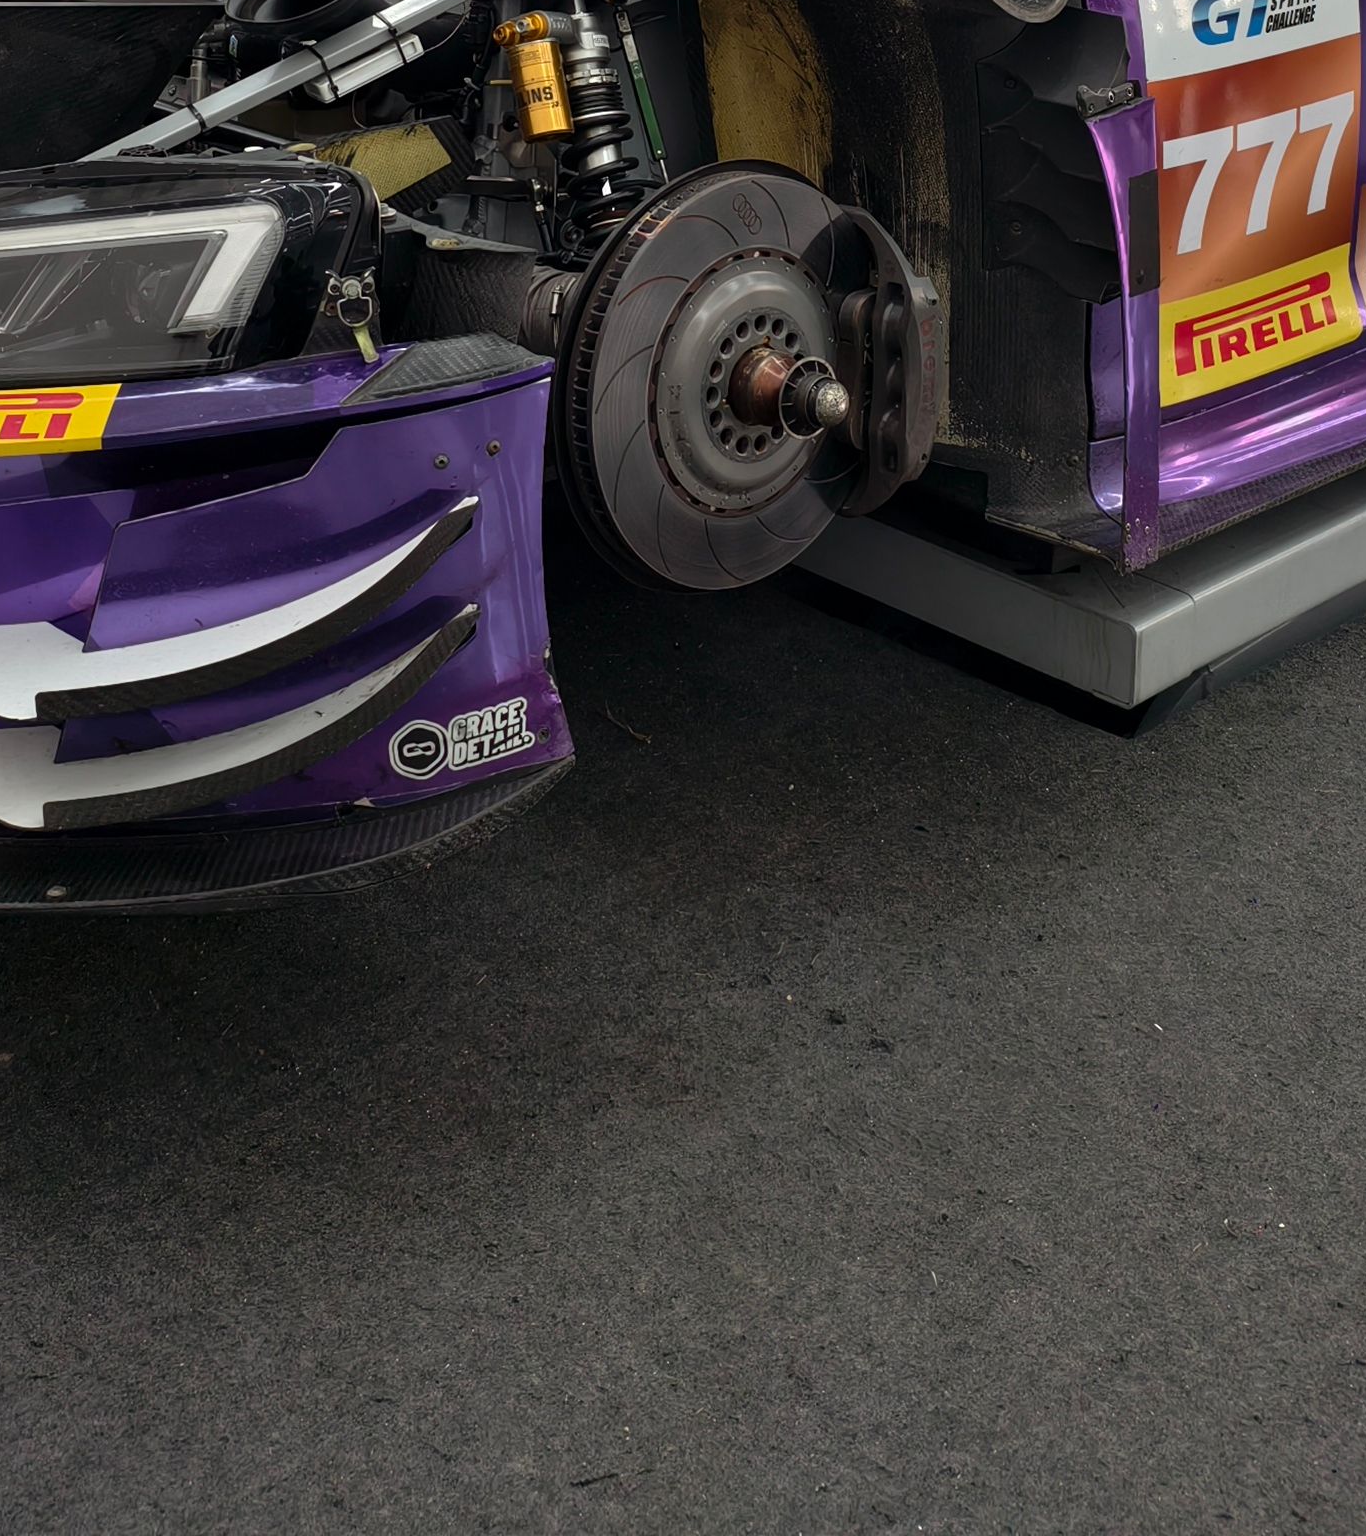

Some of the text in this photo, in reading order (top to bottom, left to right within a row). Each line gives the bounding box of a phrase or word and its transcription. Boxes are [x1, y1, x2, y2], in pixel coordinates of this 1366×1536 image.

[1265, 4, 1317, 34] CHALLENGE
[1162, 90, 1355, 255] 777
[1173, 271, 1337, 377] PIRELLI
[451, 700, 524, 742] GRACE
